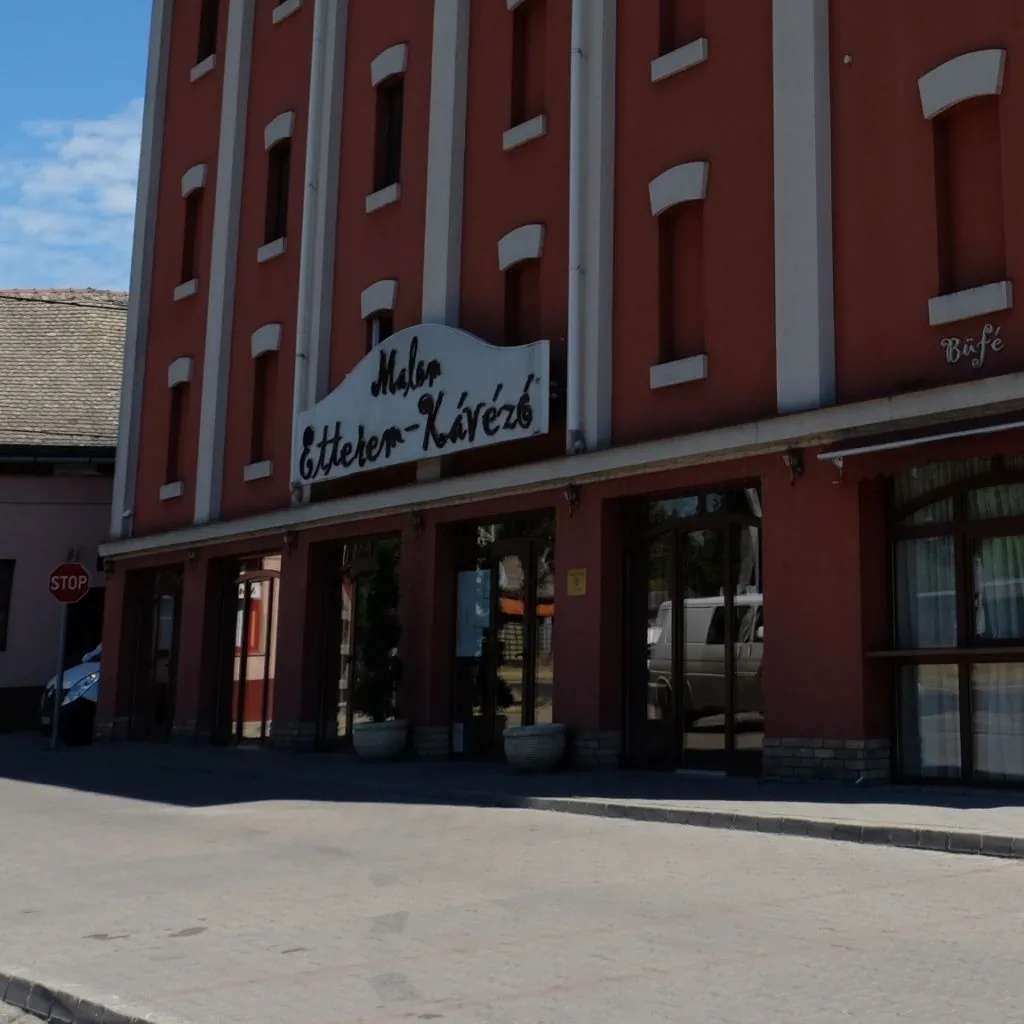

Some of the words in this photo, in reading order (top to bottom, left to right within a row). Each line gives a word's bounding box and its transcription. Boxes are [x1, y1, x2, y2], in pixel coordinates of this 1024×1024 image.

[371, 336, 441, 397] Malom
[941, 323, 1004, 369] Büfé
[51, 575, 88, 591] STOP
